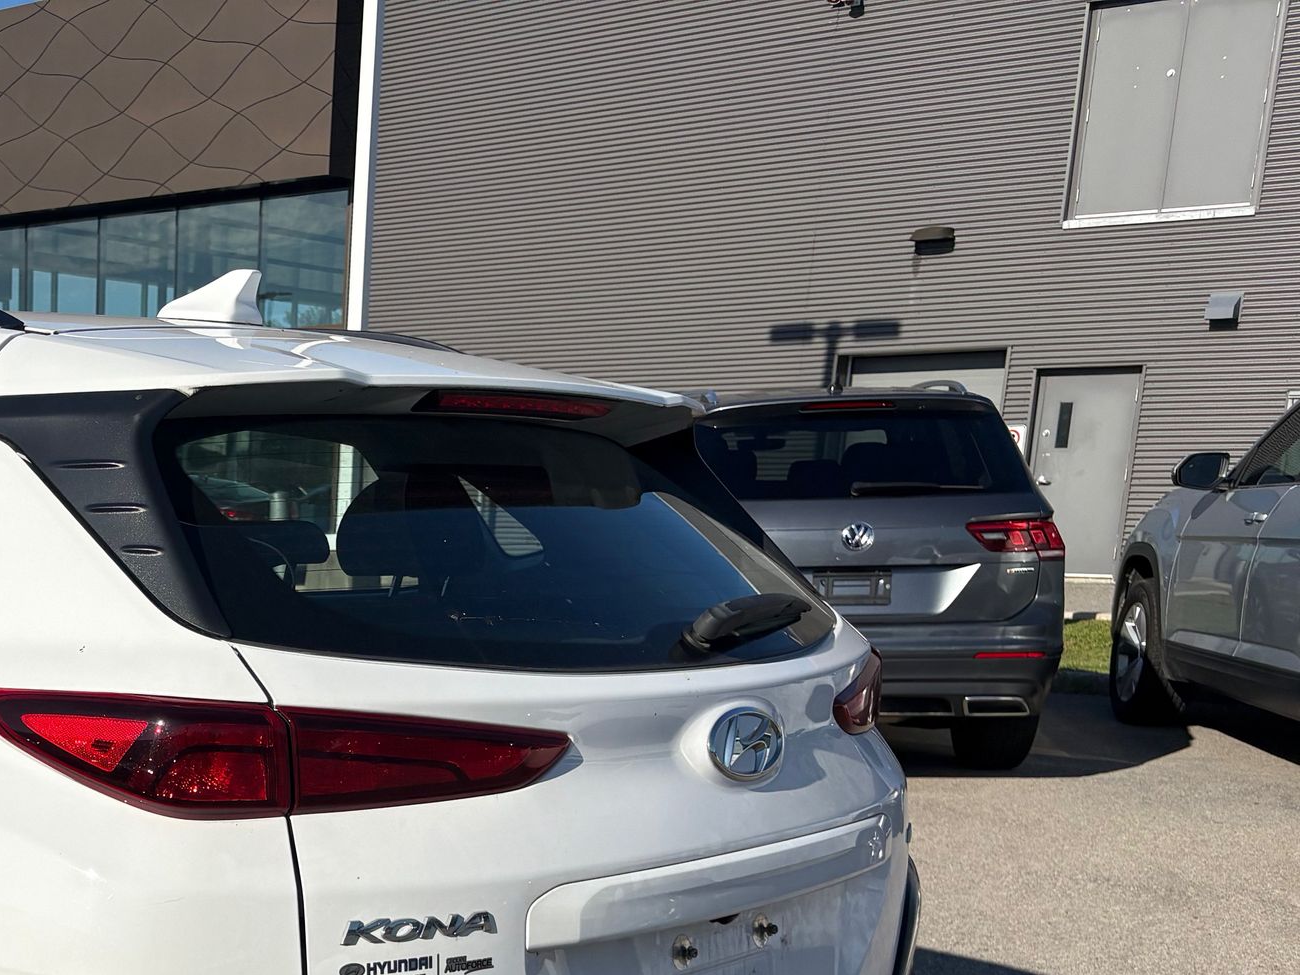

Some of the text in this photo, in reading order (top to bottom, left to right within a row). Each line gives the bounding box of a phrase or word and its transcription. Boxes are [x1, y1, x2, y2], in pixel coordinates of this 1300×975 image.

[340, 910, 498, 946] KONA
[367, 956, 433, 975] HYUNDAI
[444, 957, 493, 974] AUTOFORCE
